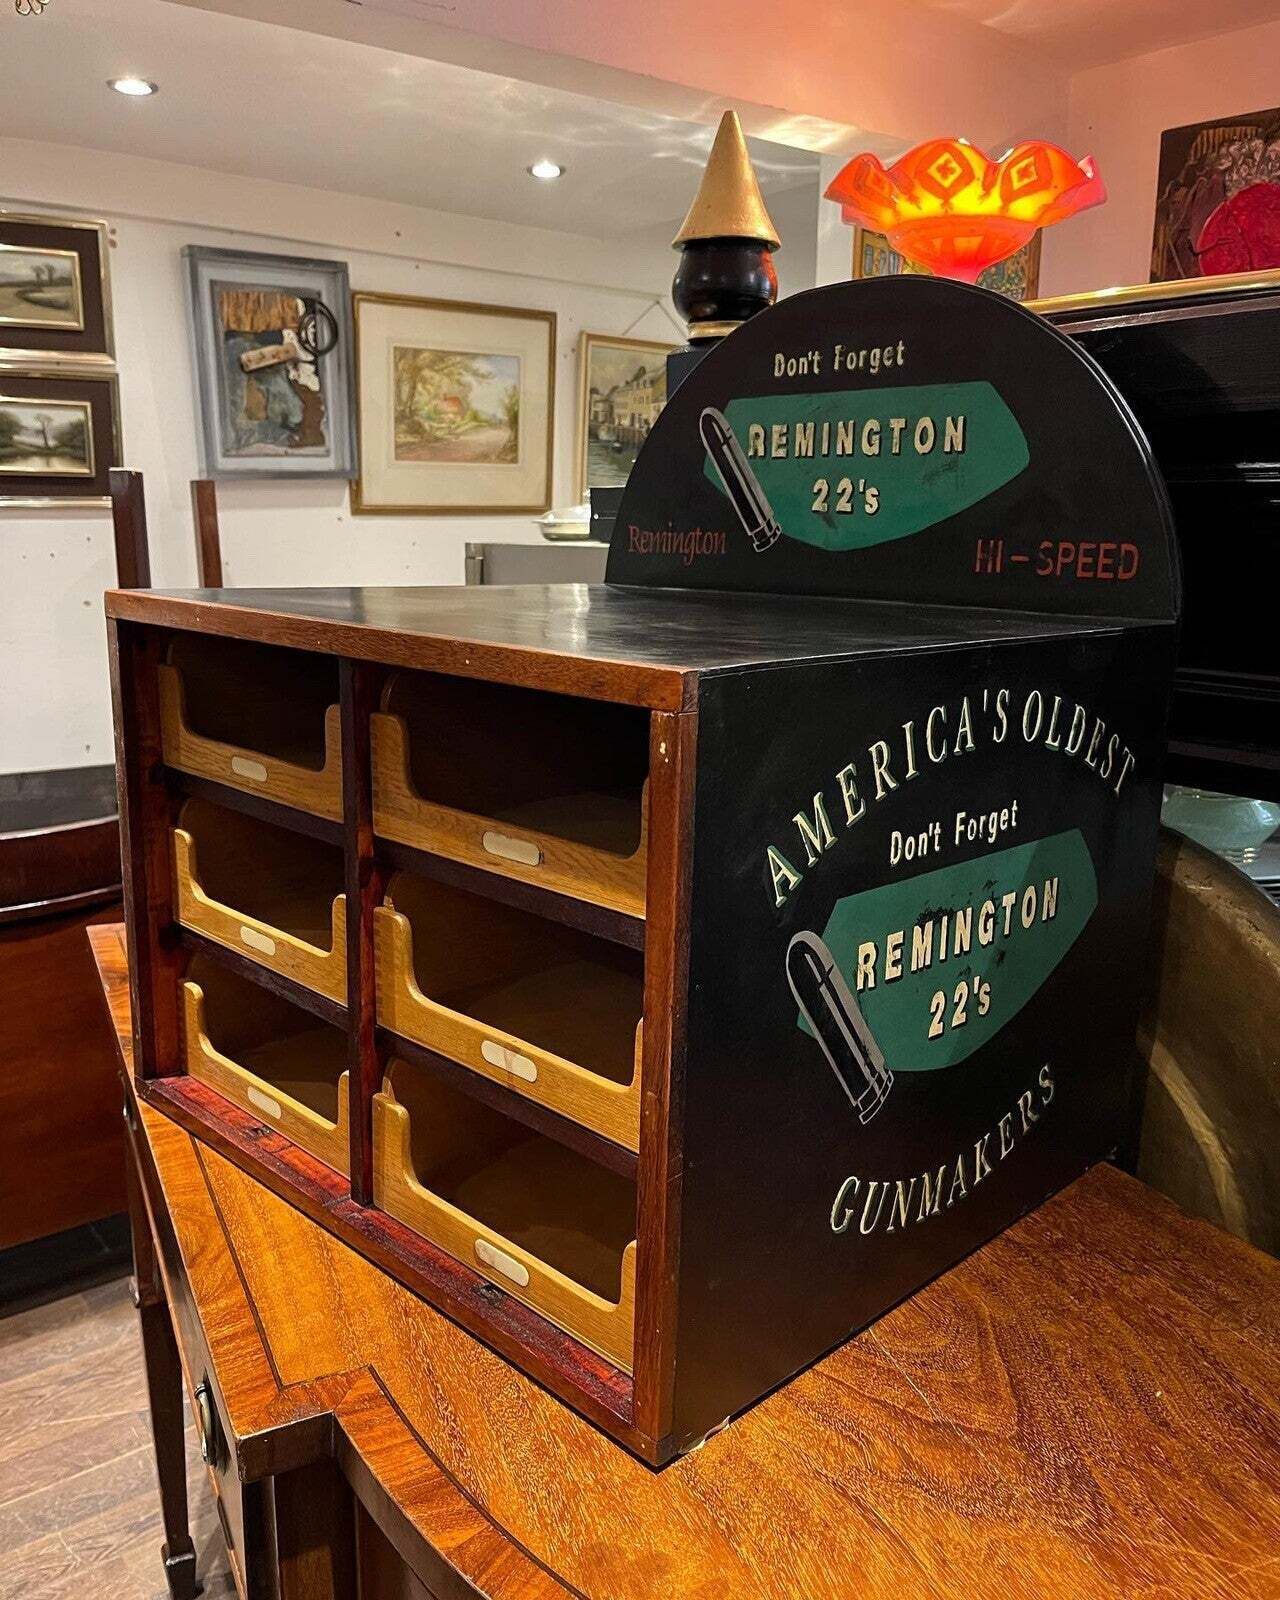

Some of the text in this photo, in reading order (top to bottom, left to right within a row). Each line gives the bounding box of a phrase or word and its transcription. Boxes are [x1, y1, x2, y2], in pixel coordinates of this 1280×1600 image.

[773, 340, 906, 377] Don't Forget
[747, 415, 966, 459] REMINGTON
[811, 478, 880, 514] 22's
[628, 522, 727, 566] Remington
[974, 539, 1004, 574] HI
[1037, 541, 1139, 577] SPEED
[766, 689, 1136, 907] AMERICA'S OLDEST
[889, 801, 1019, 865] Don't Forget
[856, 877, 1059, 990] REMINGTON
[927, 976, 992, 1040] 22's
[829, 1063, 1056, 1235] GUNMAKERS
